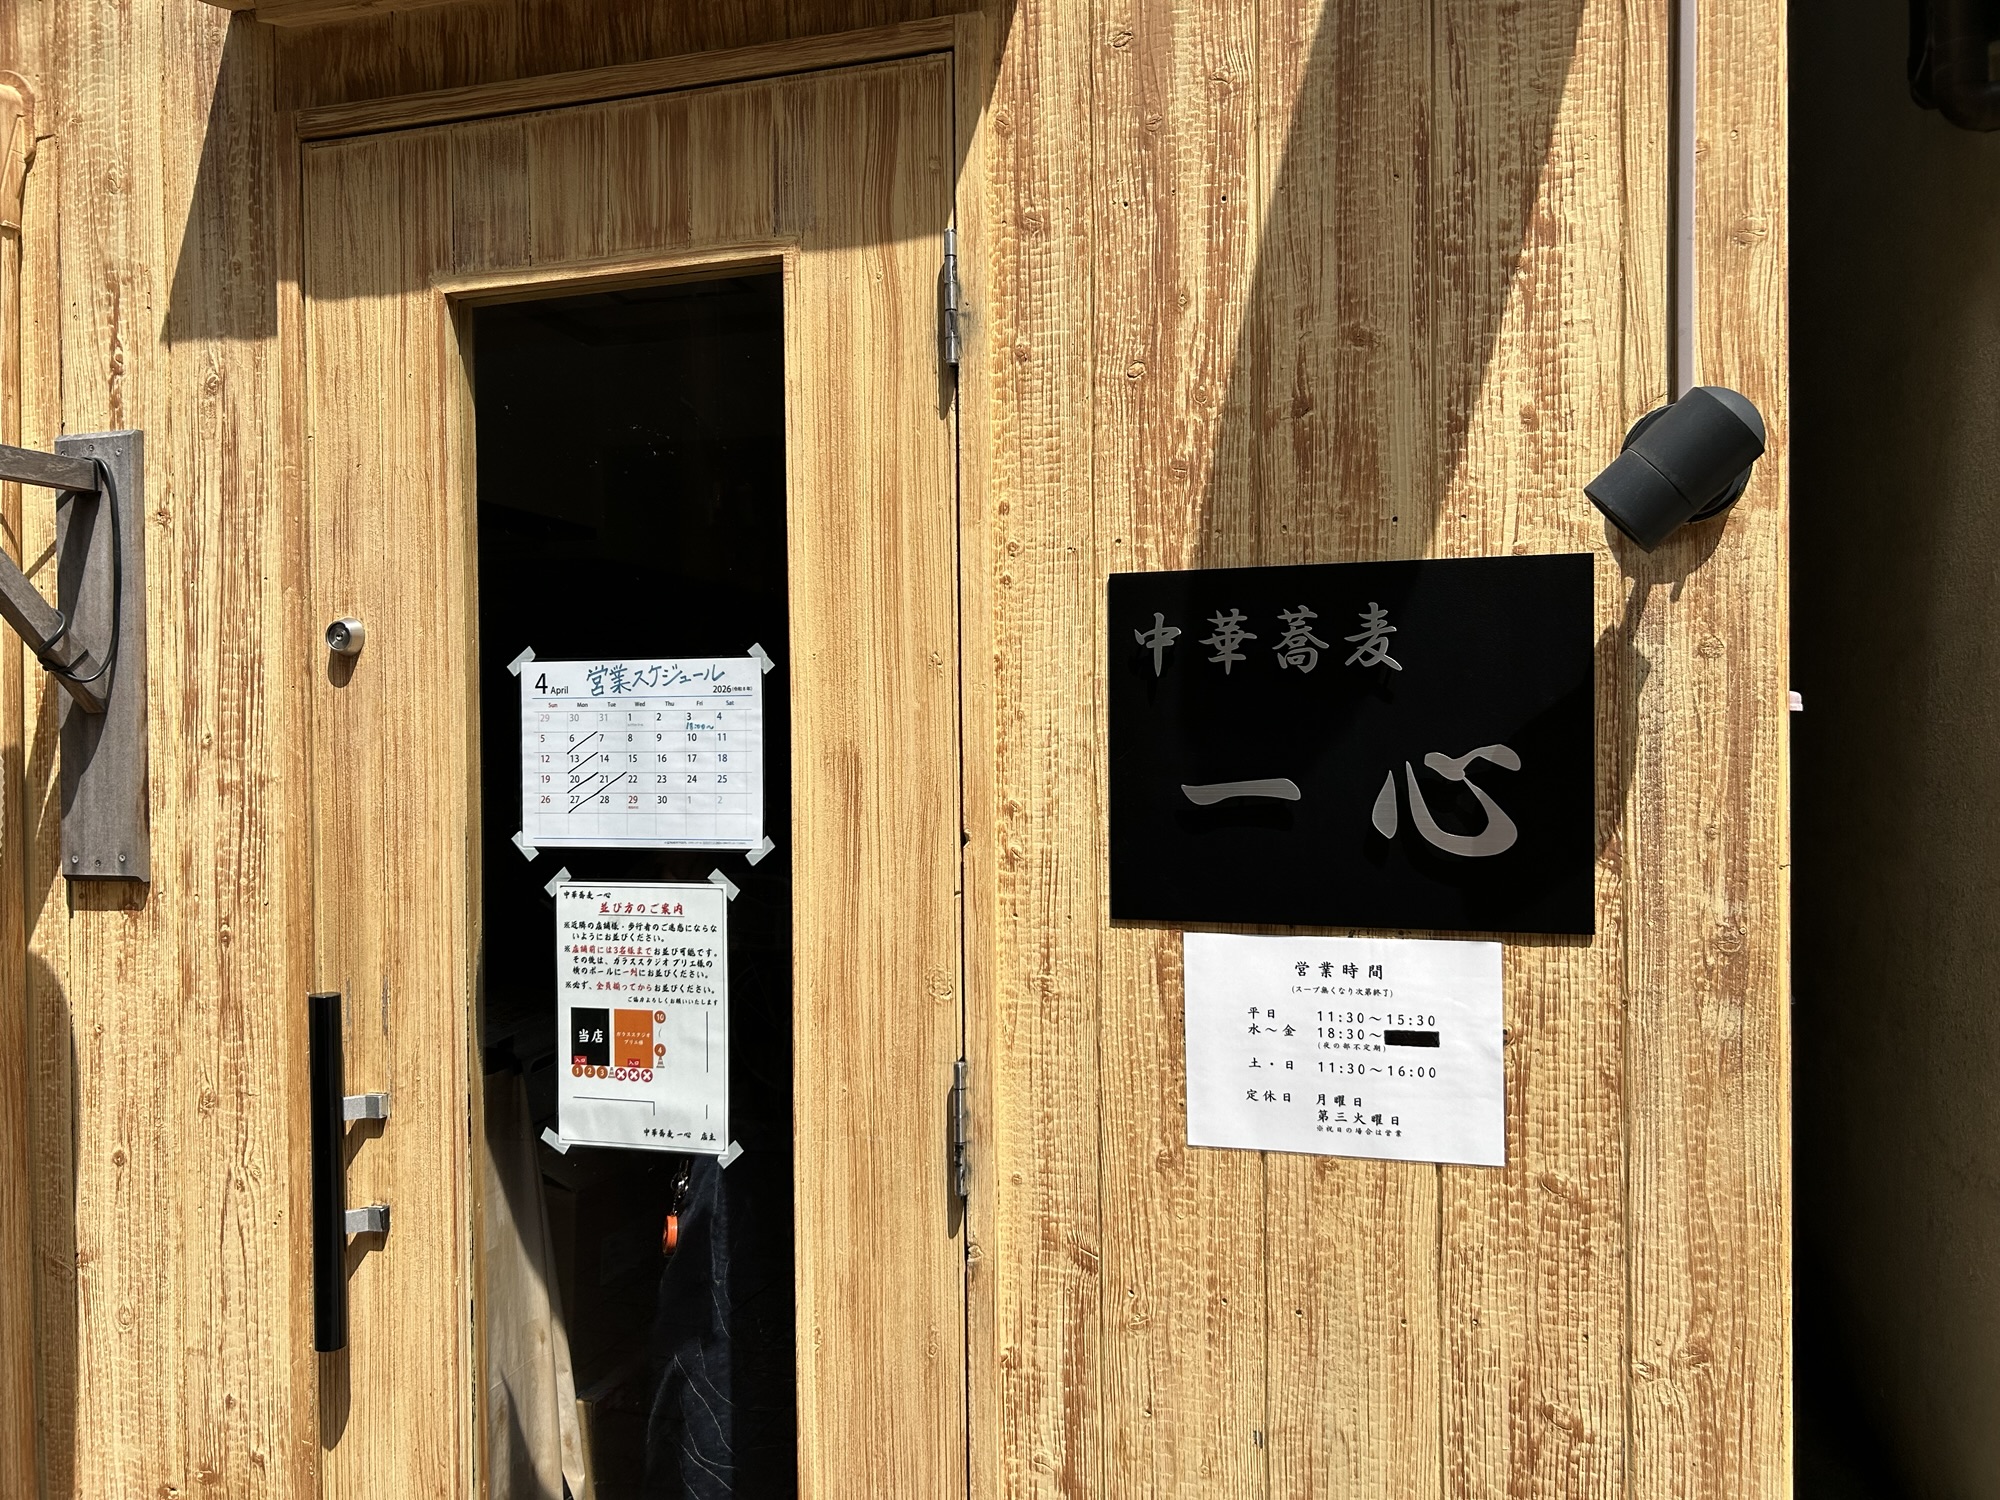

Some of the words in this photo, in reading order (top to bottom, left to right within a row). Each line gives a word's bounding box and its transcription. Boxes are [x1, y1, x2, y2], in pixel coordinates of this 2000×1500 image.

[1134, 602, 1403, 677] 中華蕎麦
[535, 673, 548, 694] 4
[550, 686, 569, 695] April
[586, 664, 725, 697] 営業スケジュール
[712, 685, 732, 693] 2026
[540, 714, 550, 722] 29
[599, 713, 608, 721] 31
[628, 713, 632, 721] 1
[656, 713, 662, 721] 2
[686, 712, 692, 721] 3
[716, 712, 722, 720] 4
[540, 734, 545, 742] 5
[569, 734, 575, 742] 6
[599, 734, 604, 742] 7
[628, 734, 633, 742] 8
[656, 734, 662, 742] 9
[687, 734, 697, 742] 10
[718, 734, 727, 742] 11
[541, 754, 550, 763] 12
[570, 754, 580, 763] 13
[600, 754, 609, 763] 14
[629, 754, 638, 763] 15
[657, 754, 667, 763] 16
[687, 754, 697, 763] 17
[718, 754, 728, 763] 18
[541, 775, 550, 783] 19
[569, 775, 580, 783] 20
[599, 775, 609, 783] 21
[628, 775, 638, 783] 22
[656, 775, 667, 783] 23
[687, 775, 697, 783] 24
[717, 775, 728, 783] 25
[540, 796, 550, 804] 26
[570, 796, 580, 804] 27
[600, 796, 610, 804] 28
[628, 796, 638, 804] 29
[657, 796, 667, 804] 30
[688, 796, 691, 804] 1
[718, 796, 723, 804] 2
[1181, 744, 1521, 857] 一心
[599, 901, 684, 915] 並び方のご案内
[572, 931, 665, 942] いようにお並びください。
[1294, 961, 1383, 980] 営業時間
[1247, 1007, 1276, 1019] 平日
[578, 1028, 603, 1043] 当店
[658, 1046, 662, 1054] 4
[1246, 1089, 1291, 1102] 定休日
[1316, 1094, 1362, 1107] 月曜日
[1317, 1109, 1400, 1126] 第三火曜日
